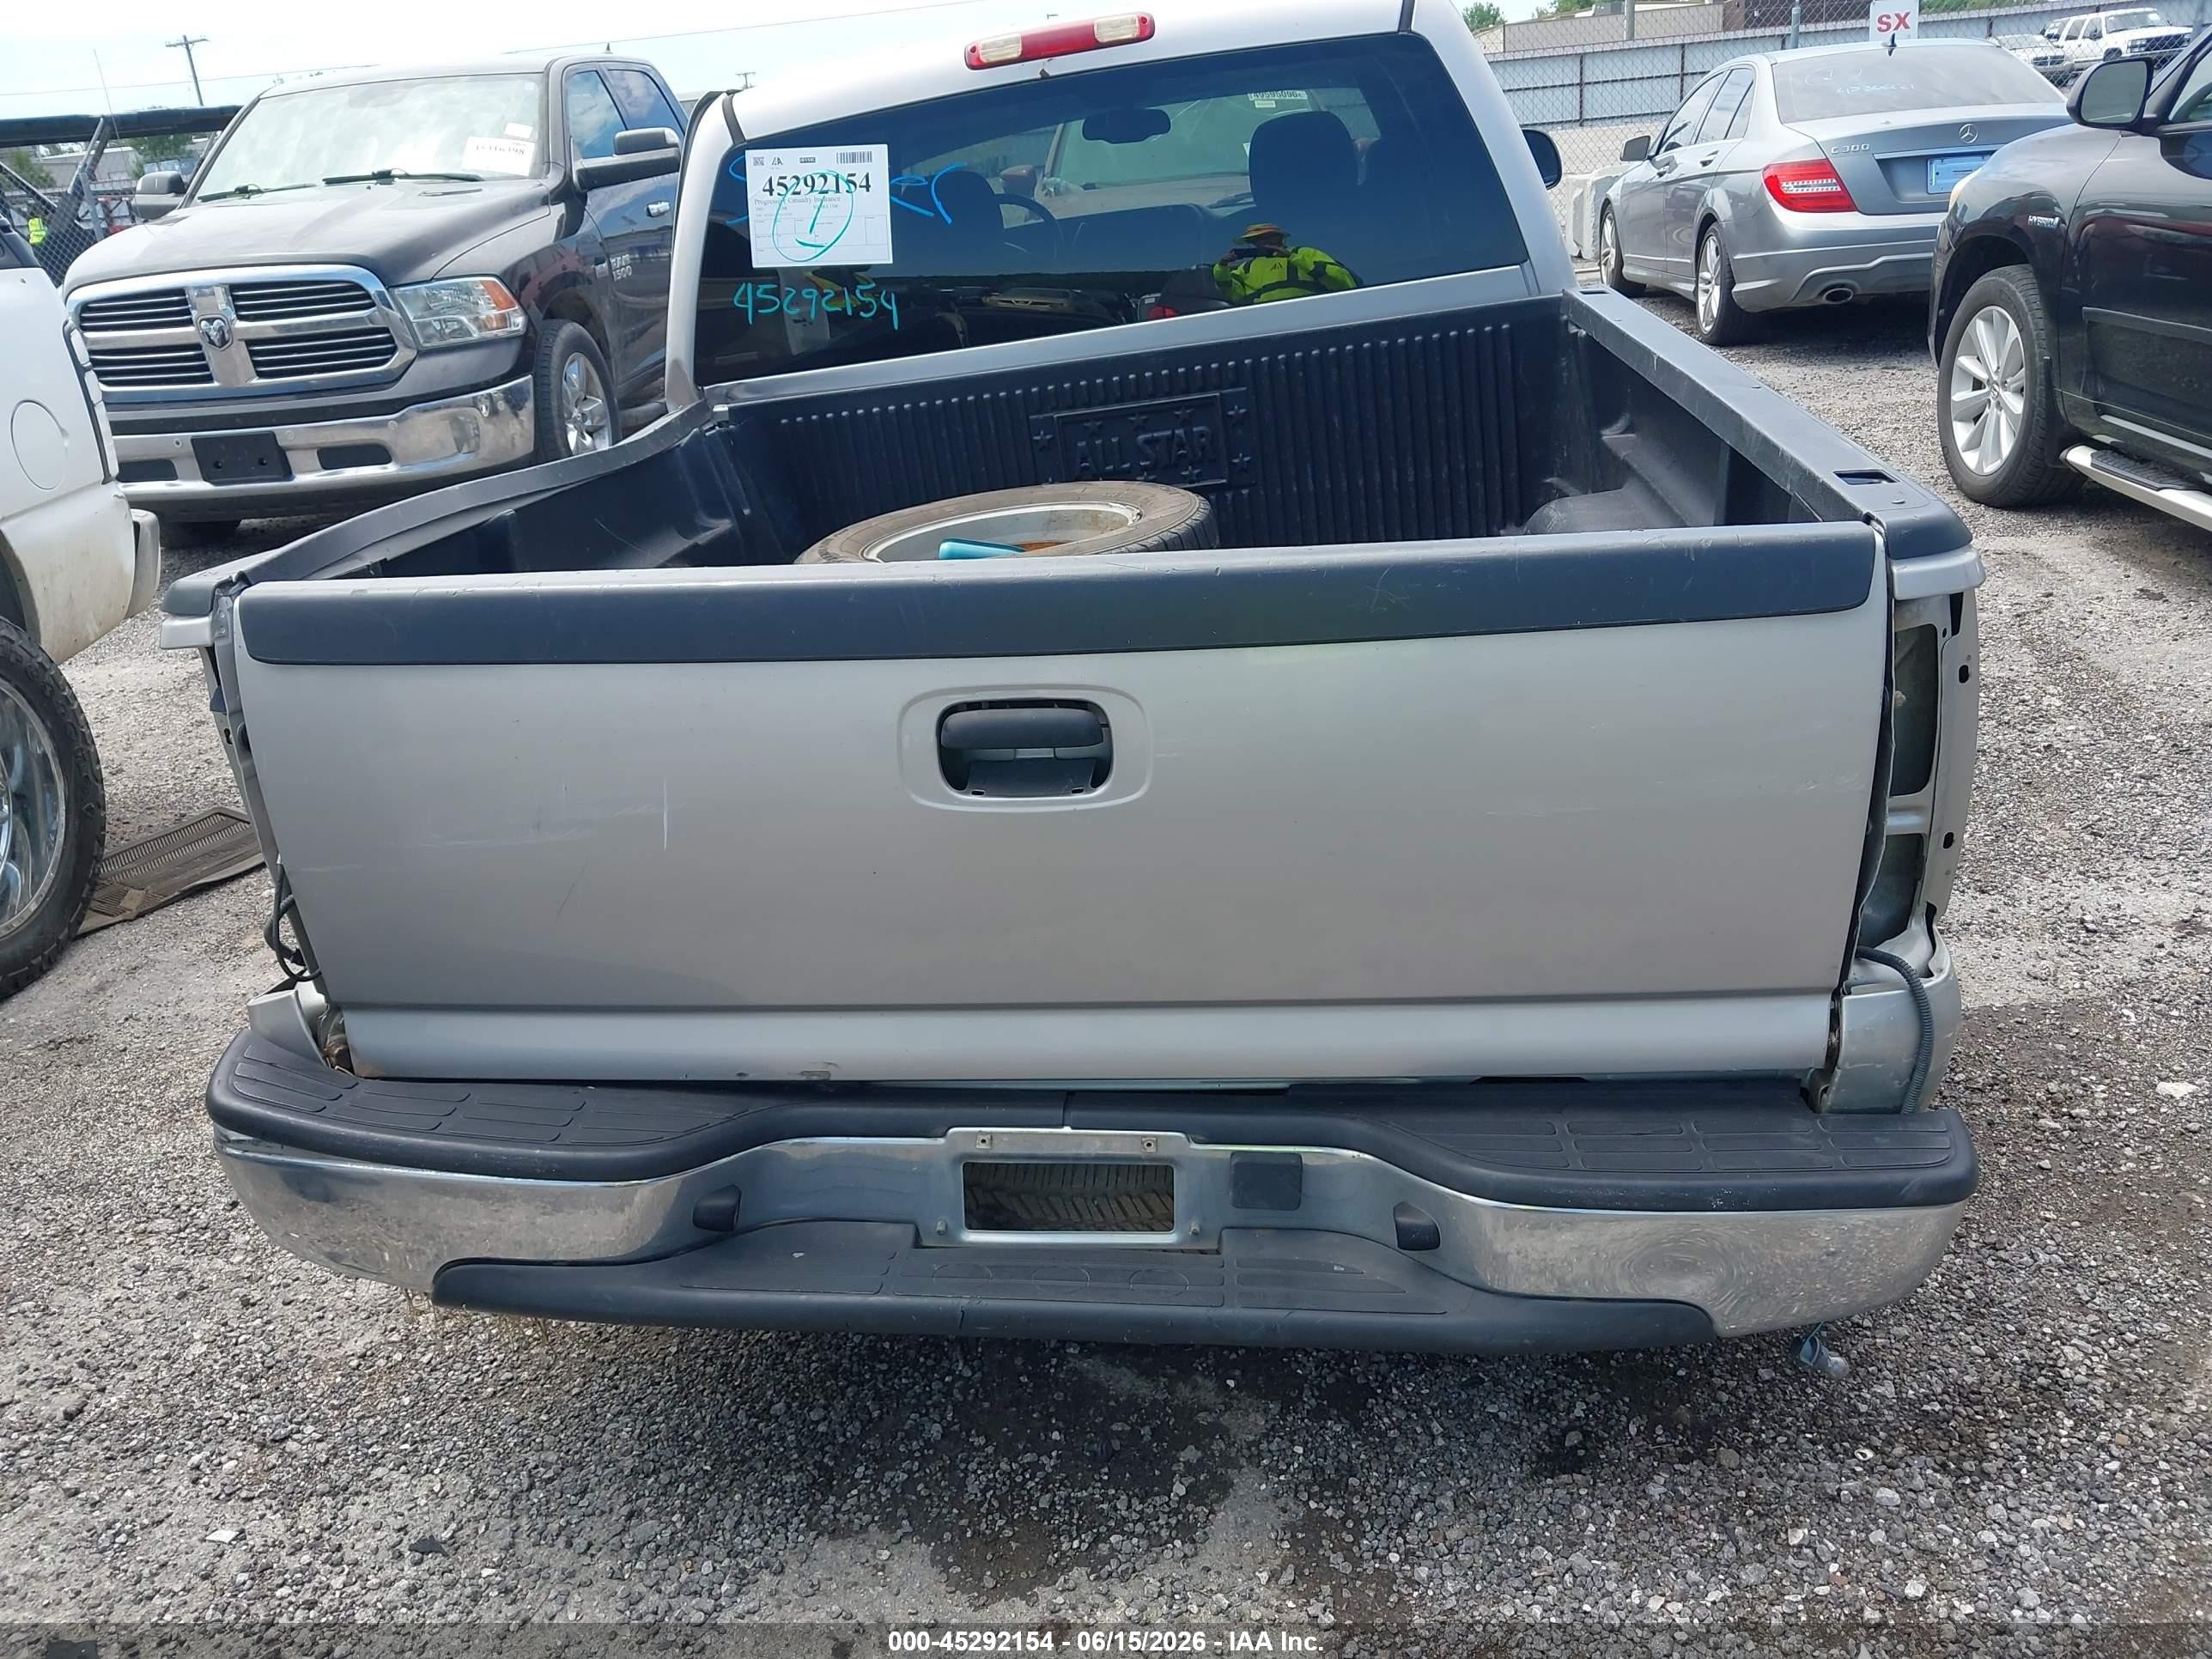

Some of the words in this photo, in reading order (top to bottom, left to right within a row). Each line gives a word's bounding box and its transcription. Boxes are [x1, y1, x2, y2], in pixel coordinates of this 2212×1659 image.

[1876, 10, 1911, 33] SX
[763, 172, 872, 197] 45292154
[733, 283, 898, 330] 45292154
[1077, 436, 1131, 472] ALL
[1136, 426, 1212, 468] STAR
